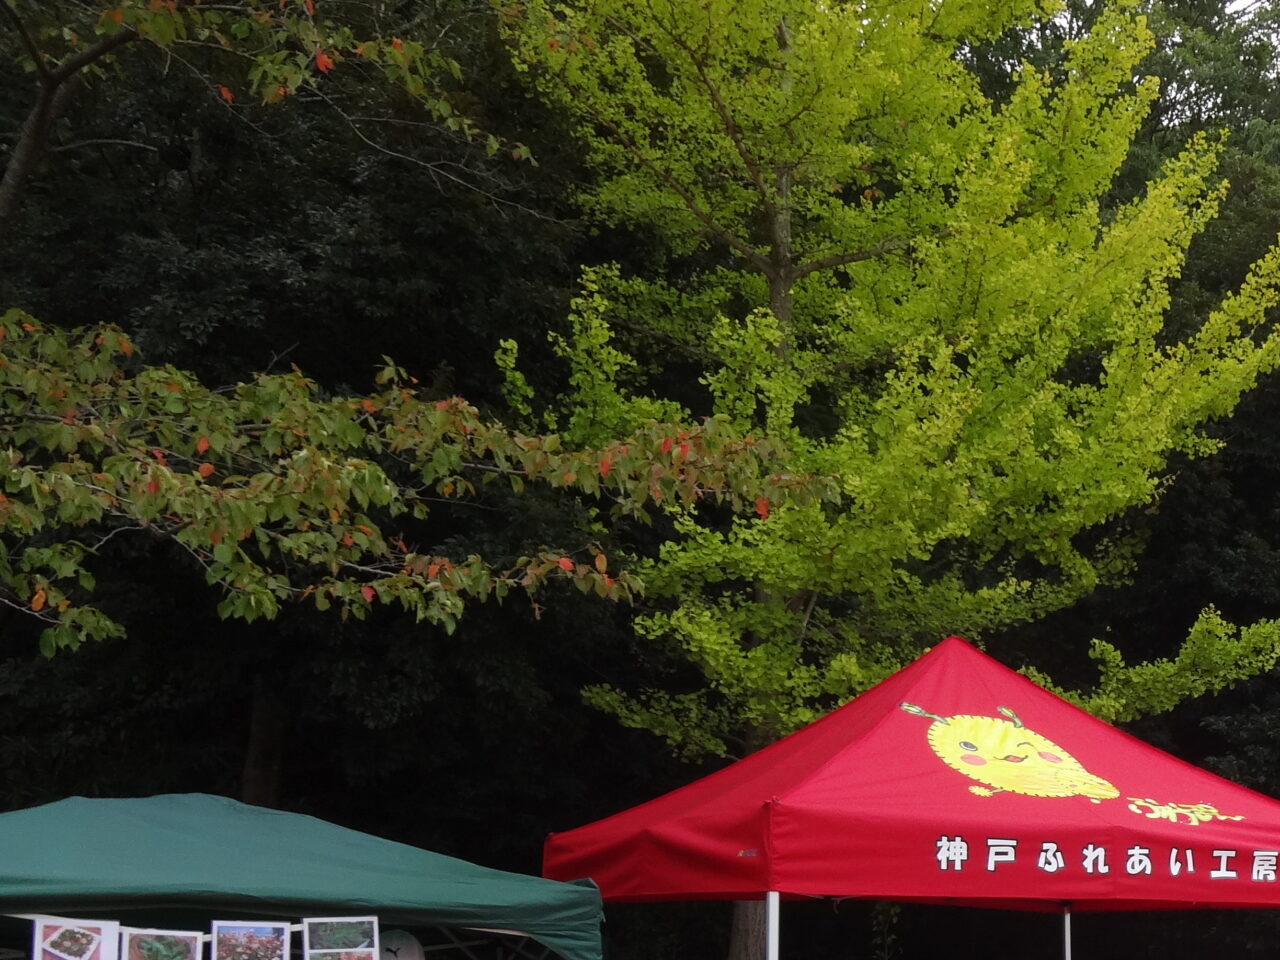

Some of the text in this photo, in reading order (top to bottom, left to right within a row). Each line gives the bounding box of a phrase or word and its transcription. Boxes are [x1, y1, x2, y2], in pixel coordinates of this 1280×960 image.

[936, 835, 1279, 881] 神戸ふれあい工房
